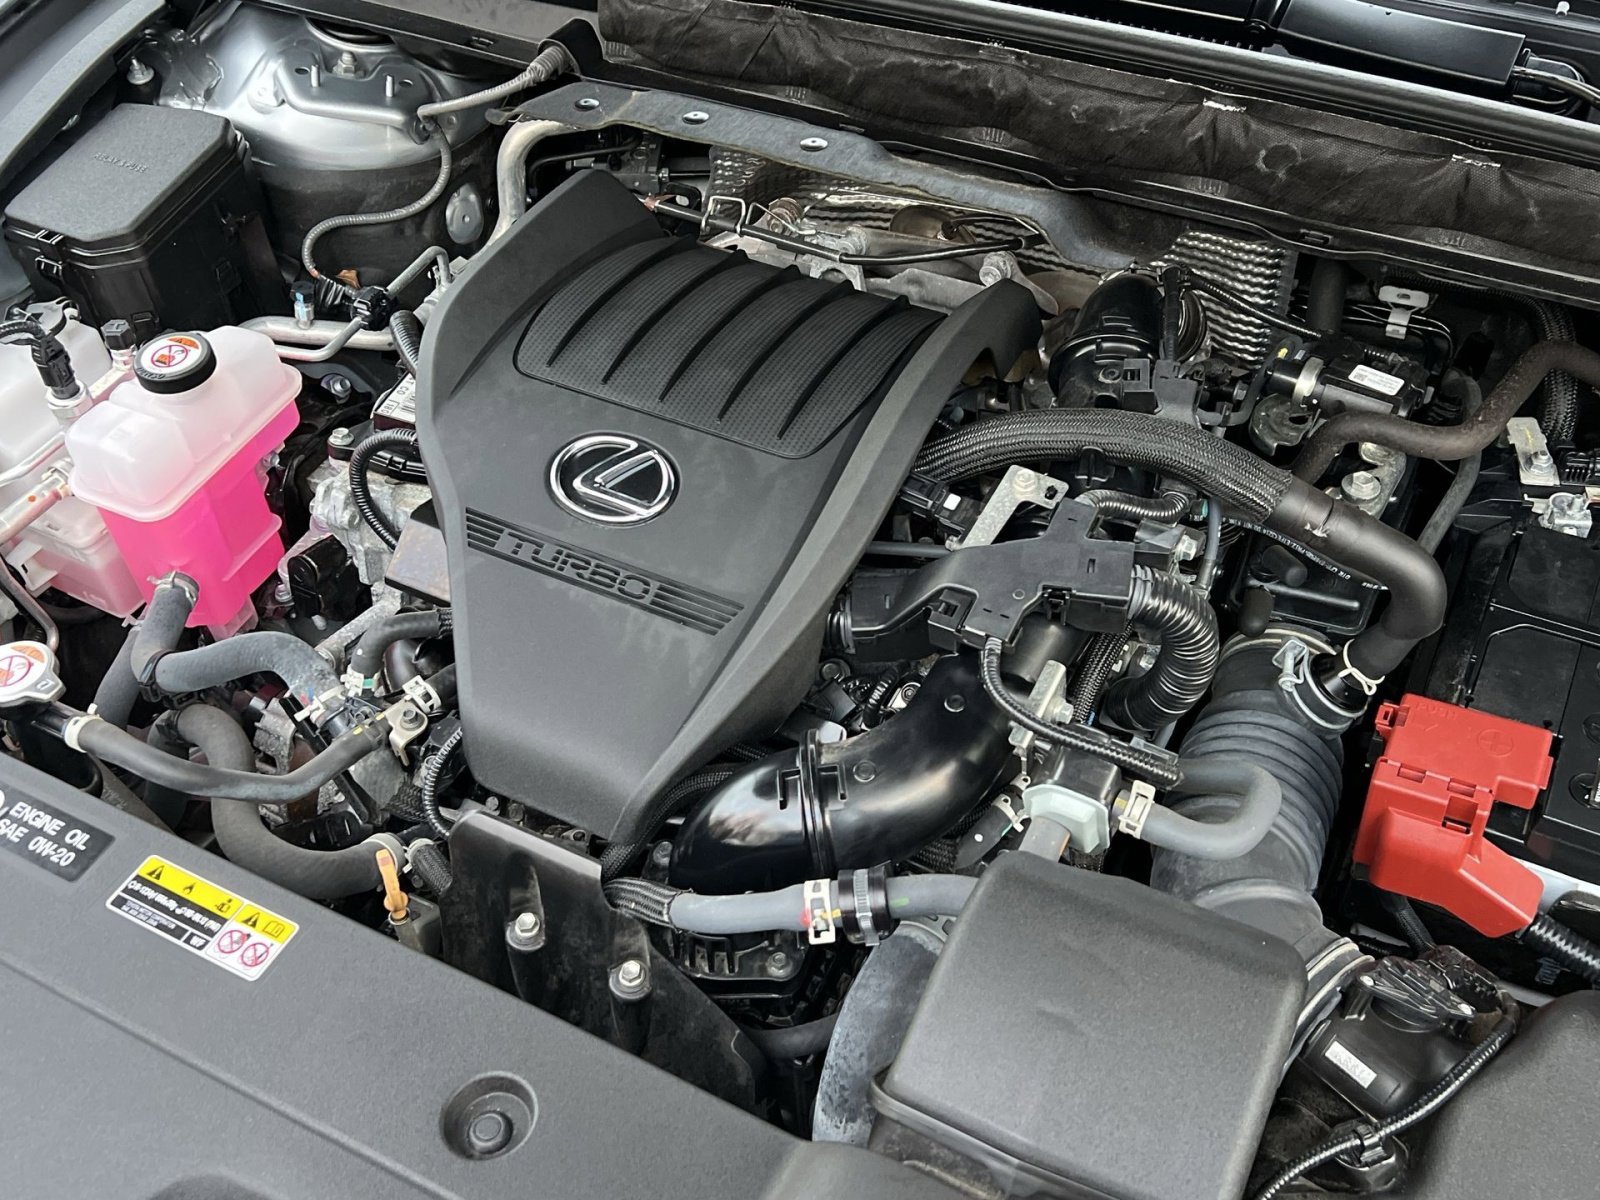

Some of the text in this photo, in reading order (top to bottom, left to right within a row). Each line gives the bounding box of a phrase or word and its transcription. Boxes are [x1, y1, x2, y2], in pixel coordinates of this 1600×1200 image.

[508, 531, 652, 601] TURBO
[0, 818, 76, 867] SAE 0W-20
[9, 801, 91, 851] ENGINE OIL
